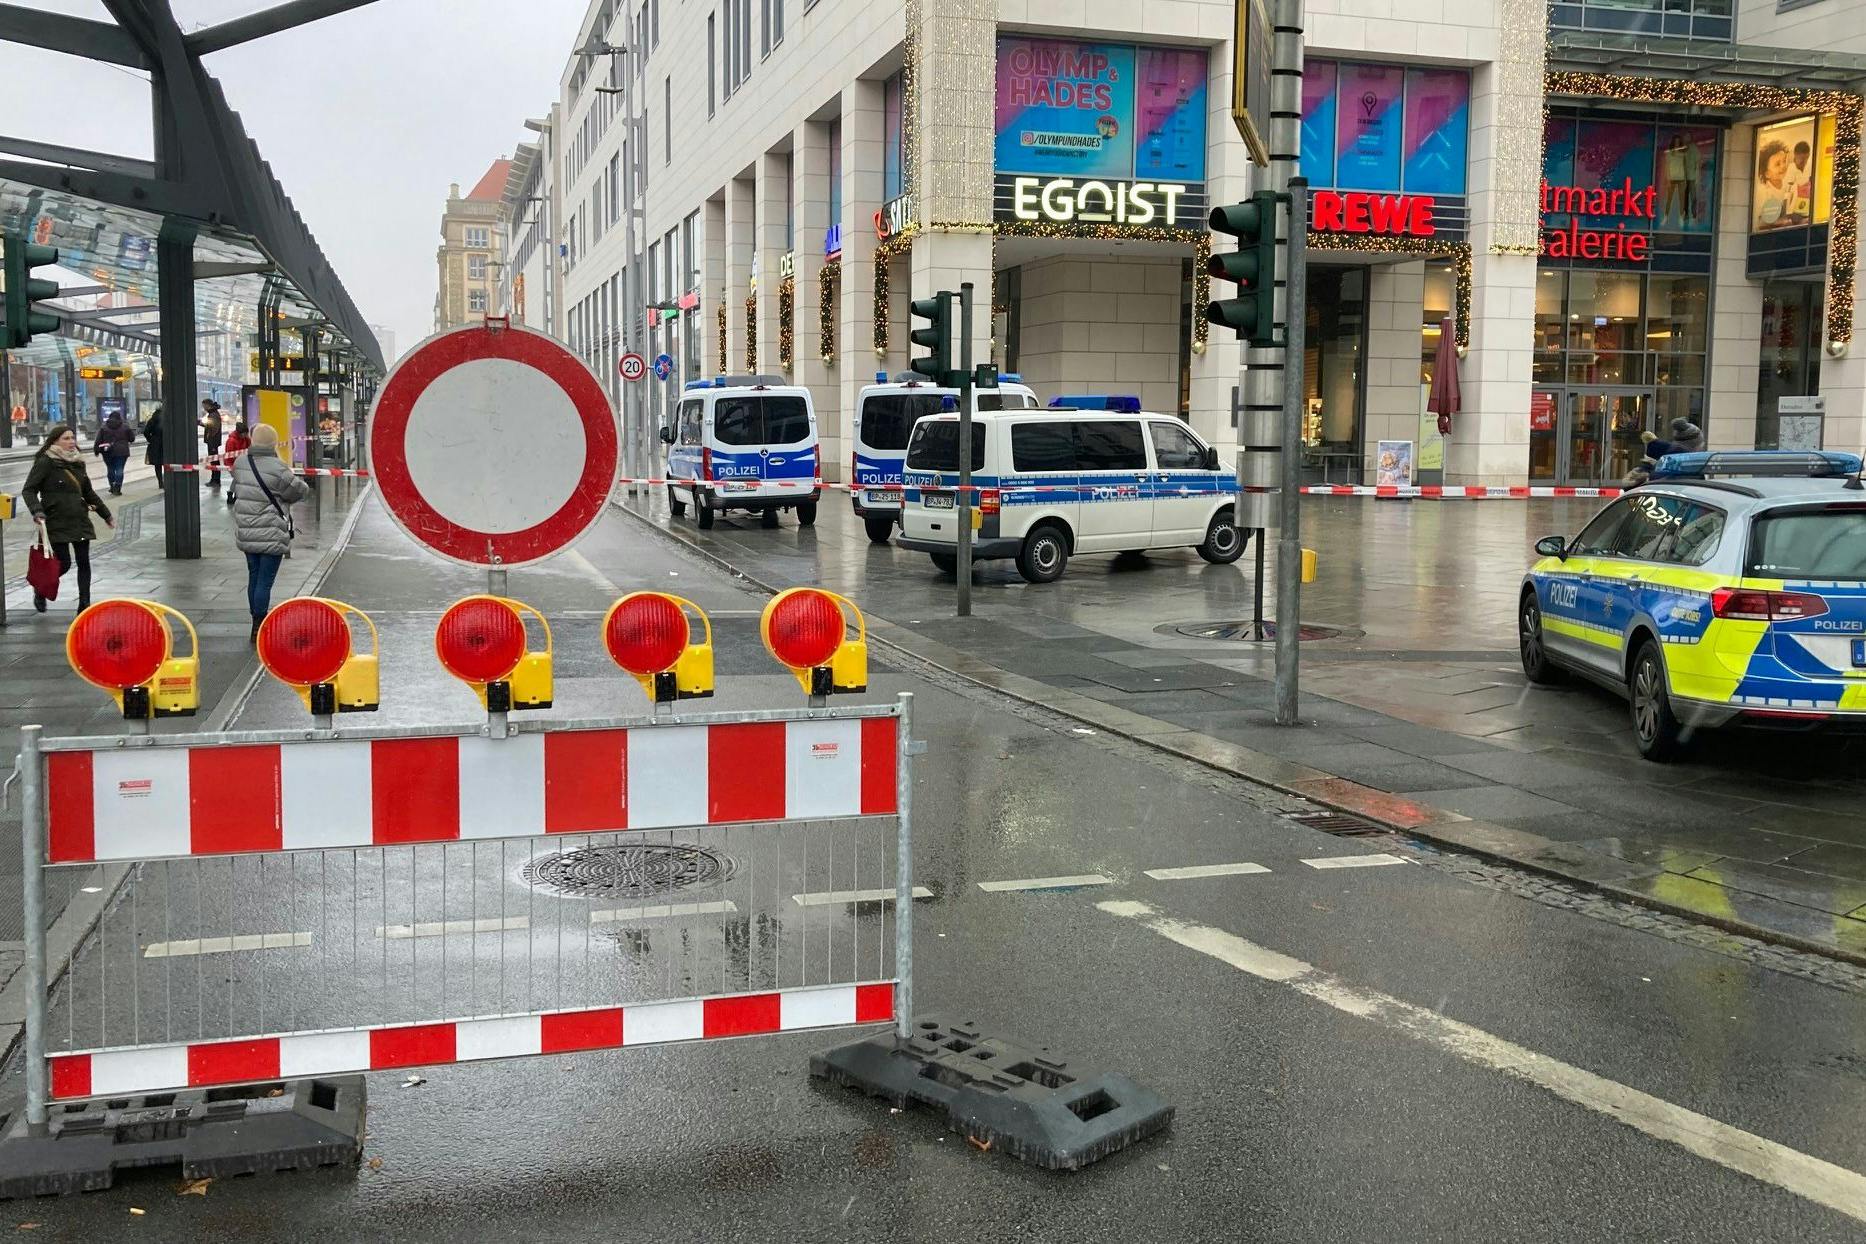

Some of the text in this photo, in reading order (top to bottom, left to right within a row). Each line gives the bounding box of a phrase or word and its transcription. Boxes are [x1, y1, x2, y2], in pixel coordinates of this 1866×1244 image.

[1010, 47, 1119, 81] OLYMP &
[1010, 77, 1112, 111] HADES
[1015, 177, 1186, 224] EGOIST
[1312, 190, 1435, 235] REWE
[1538, 217, 1648, 260] alerie
[625, 361, 640, 373] 20
[718, 465, 760, 476] POLIZEI
[862, 473, 902, 484] POLIZE
[904, 474, 933, 487] POLIZEI
[1091, 485, 1139, 500] POLIZEI
[1550, 582, 1578, 609] POLIZEI
[1814, 620, 1863, 631] POLIZEI
